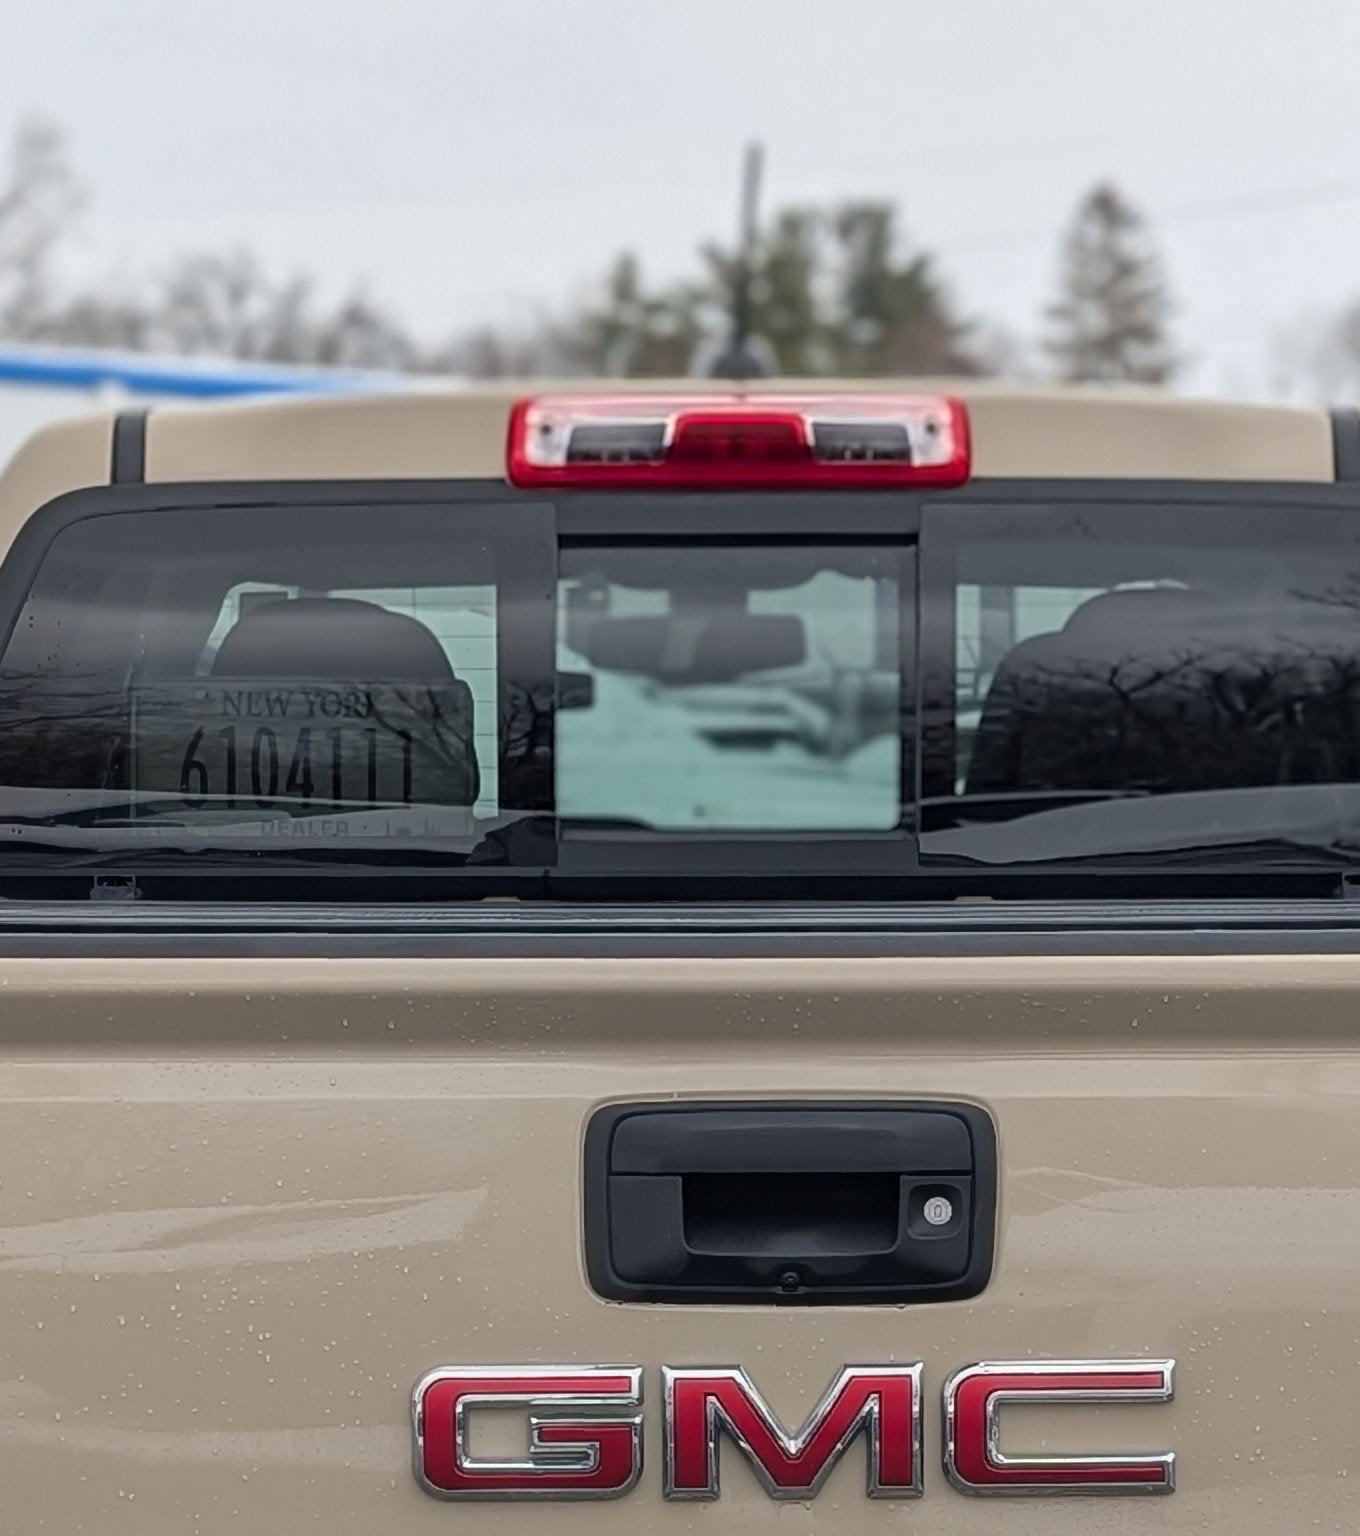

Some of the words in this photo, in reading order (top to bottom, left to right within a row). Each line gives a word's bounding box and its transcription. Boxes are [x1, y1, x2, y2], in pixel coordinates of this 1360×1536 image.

[222, 690, 292, 718] NEW
[180, 725, 413, 810] 6104111
[261, 819, 349, 837] DEALER
[412, 1359, 1177, 1502] GMC
